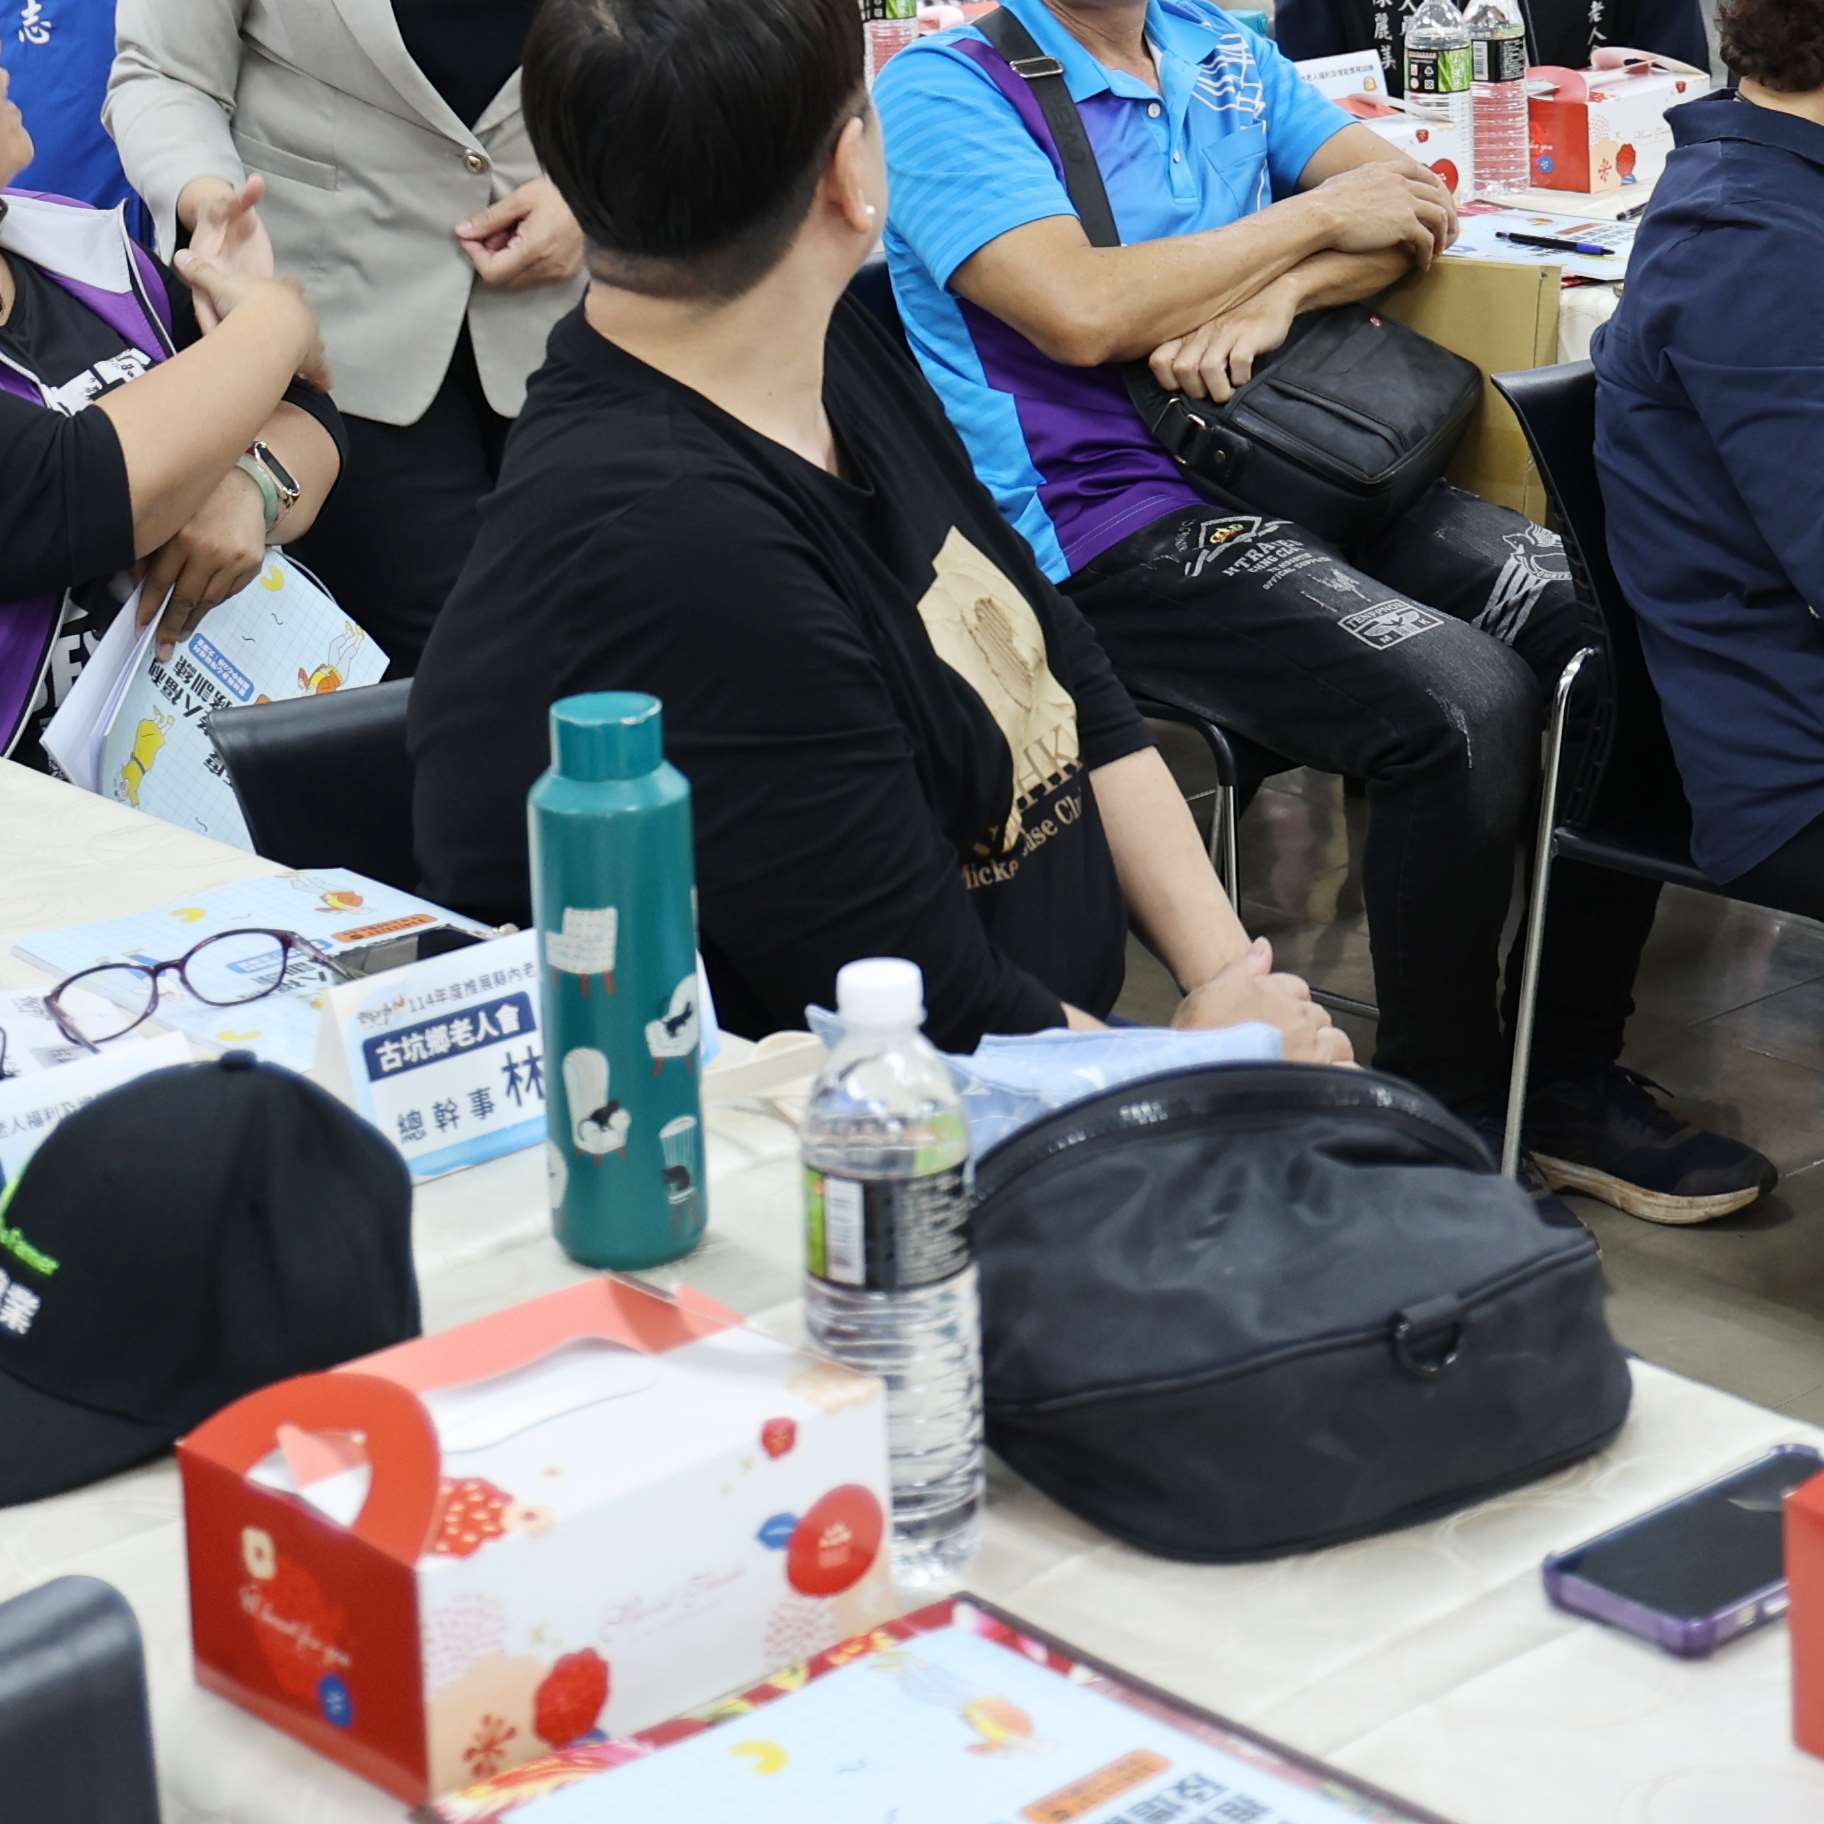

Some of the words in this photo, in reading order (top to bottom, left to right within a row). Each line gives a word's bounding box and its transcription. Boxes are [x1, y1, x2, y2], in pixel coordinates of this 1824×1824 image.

[376, 1003, 521, 1072] 古坑鄉老人會
